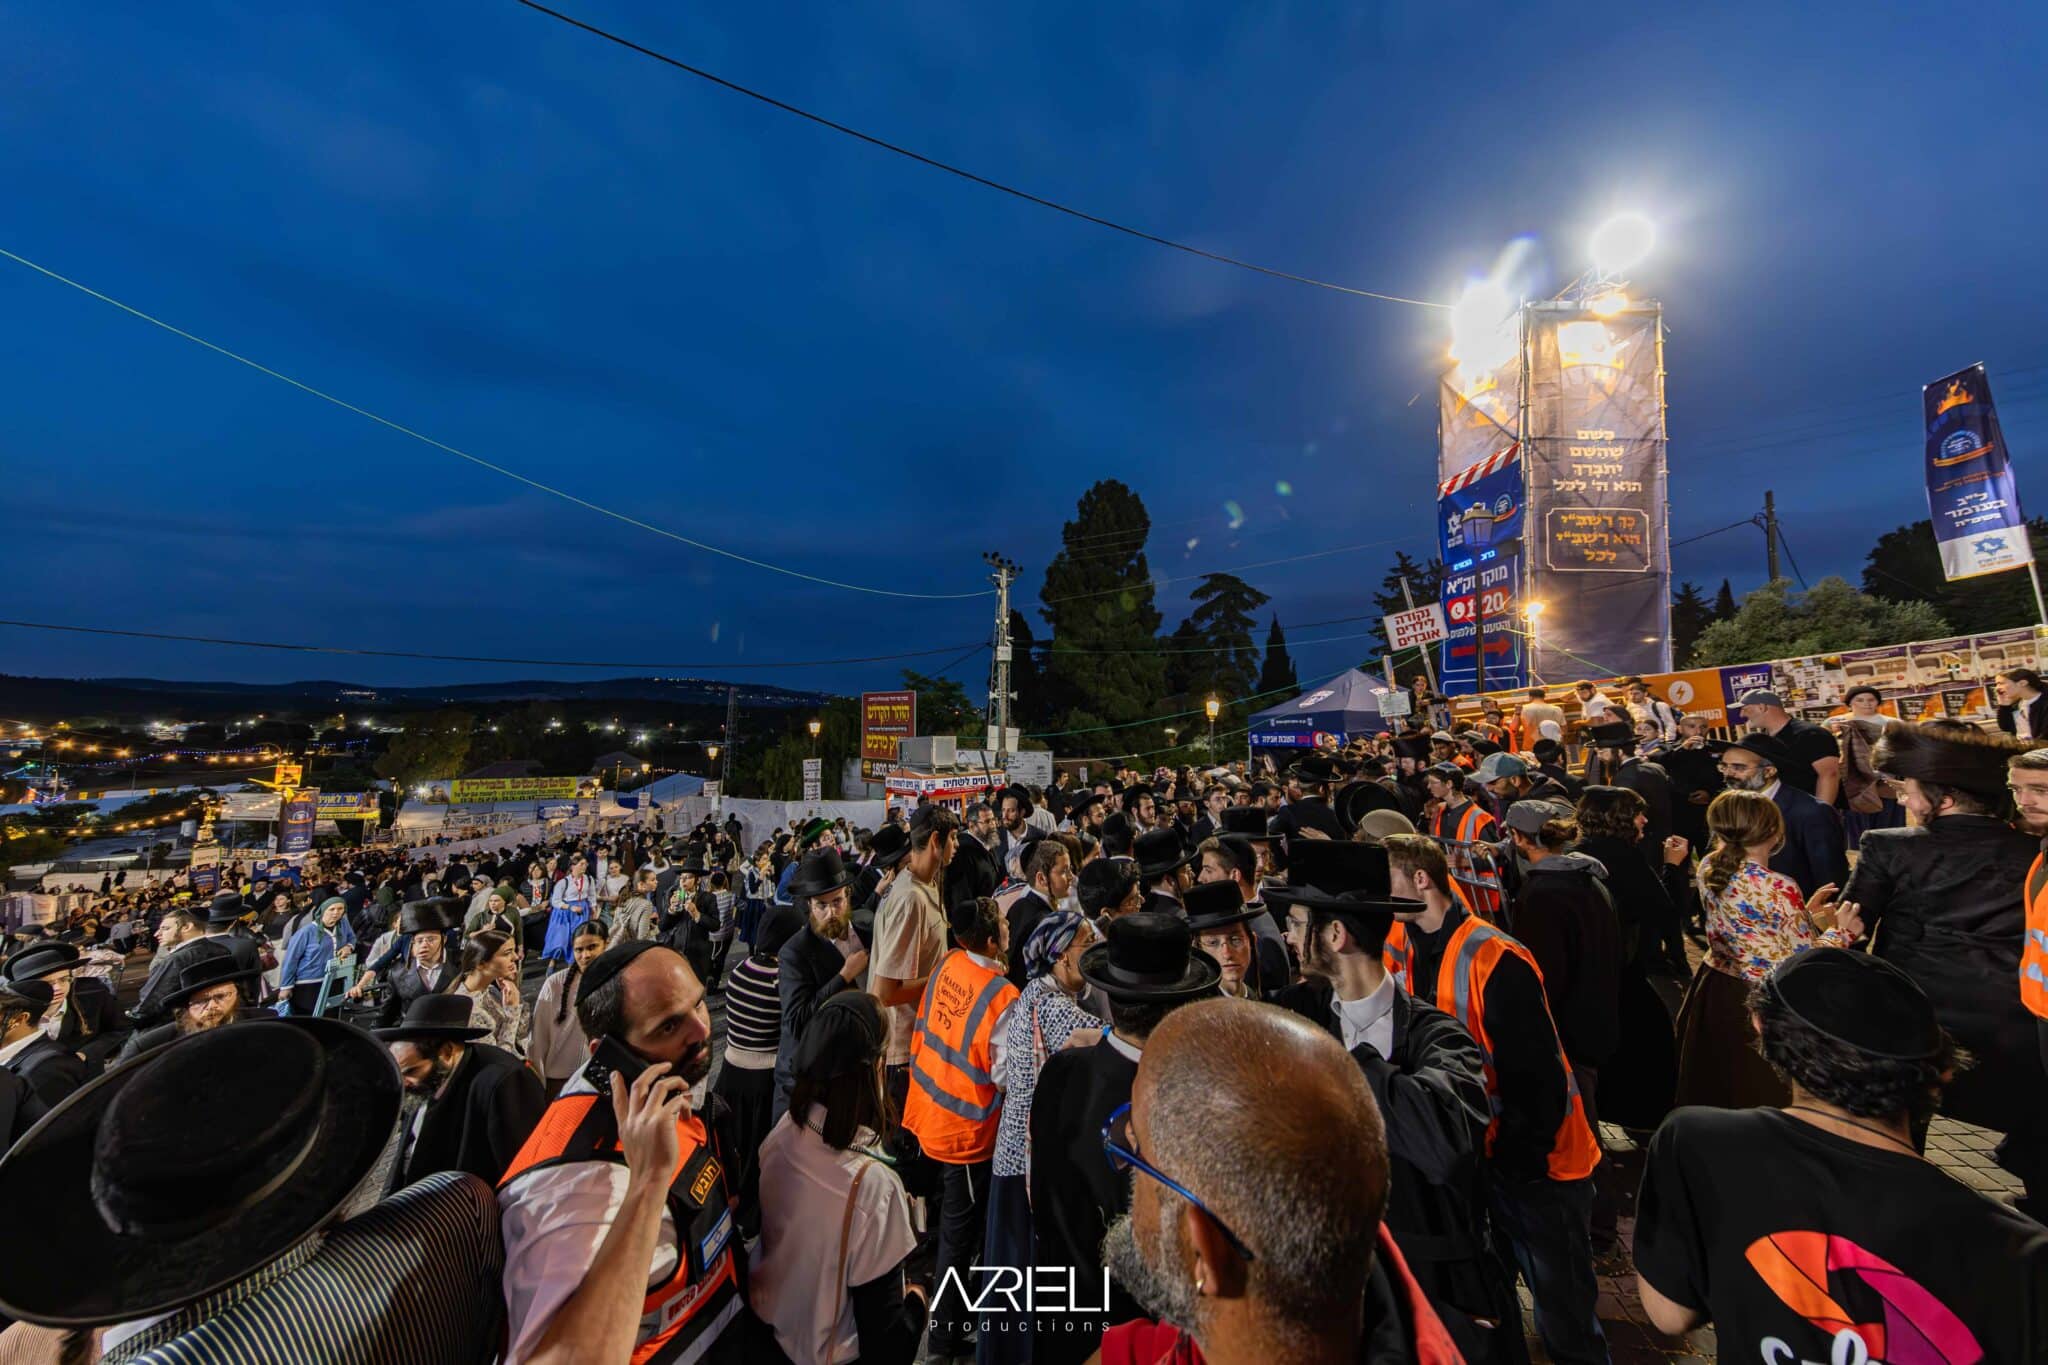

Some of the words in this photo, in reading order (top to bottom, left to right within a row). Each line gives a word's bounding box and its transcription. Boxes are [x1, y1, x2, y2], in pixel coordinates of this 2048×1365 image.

[1481, 565, 1508, 588] מוקד
[1395, 607, 1431, 625] נקודה
[1396, 617, 1435, 637] לילדים
[1397, 627, 1440, 647] אובדים
[943, 777, 970, 788] לשתיה
[972, 776, 986, 785] מים
[694, 1162, 720, 1199] חובש
